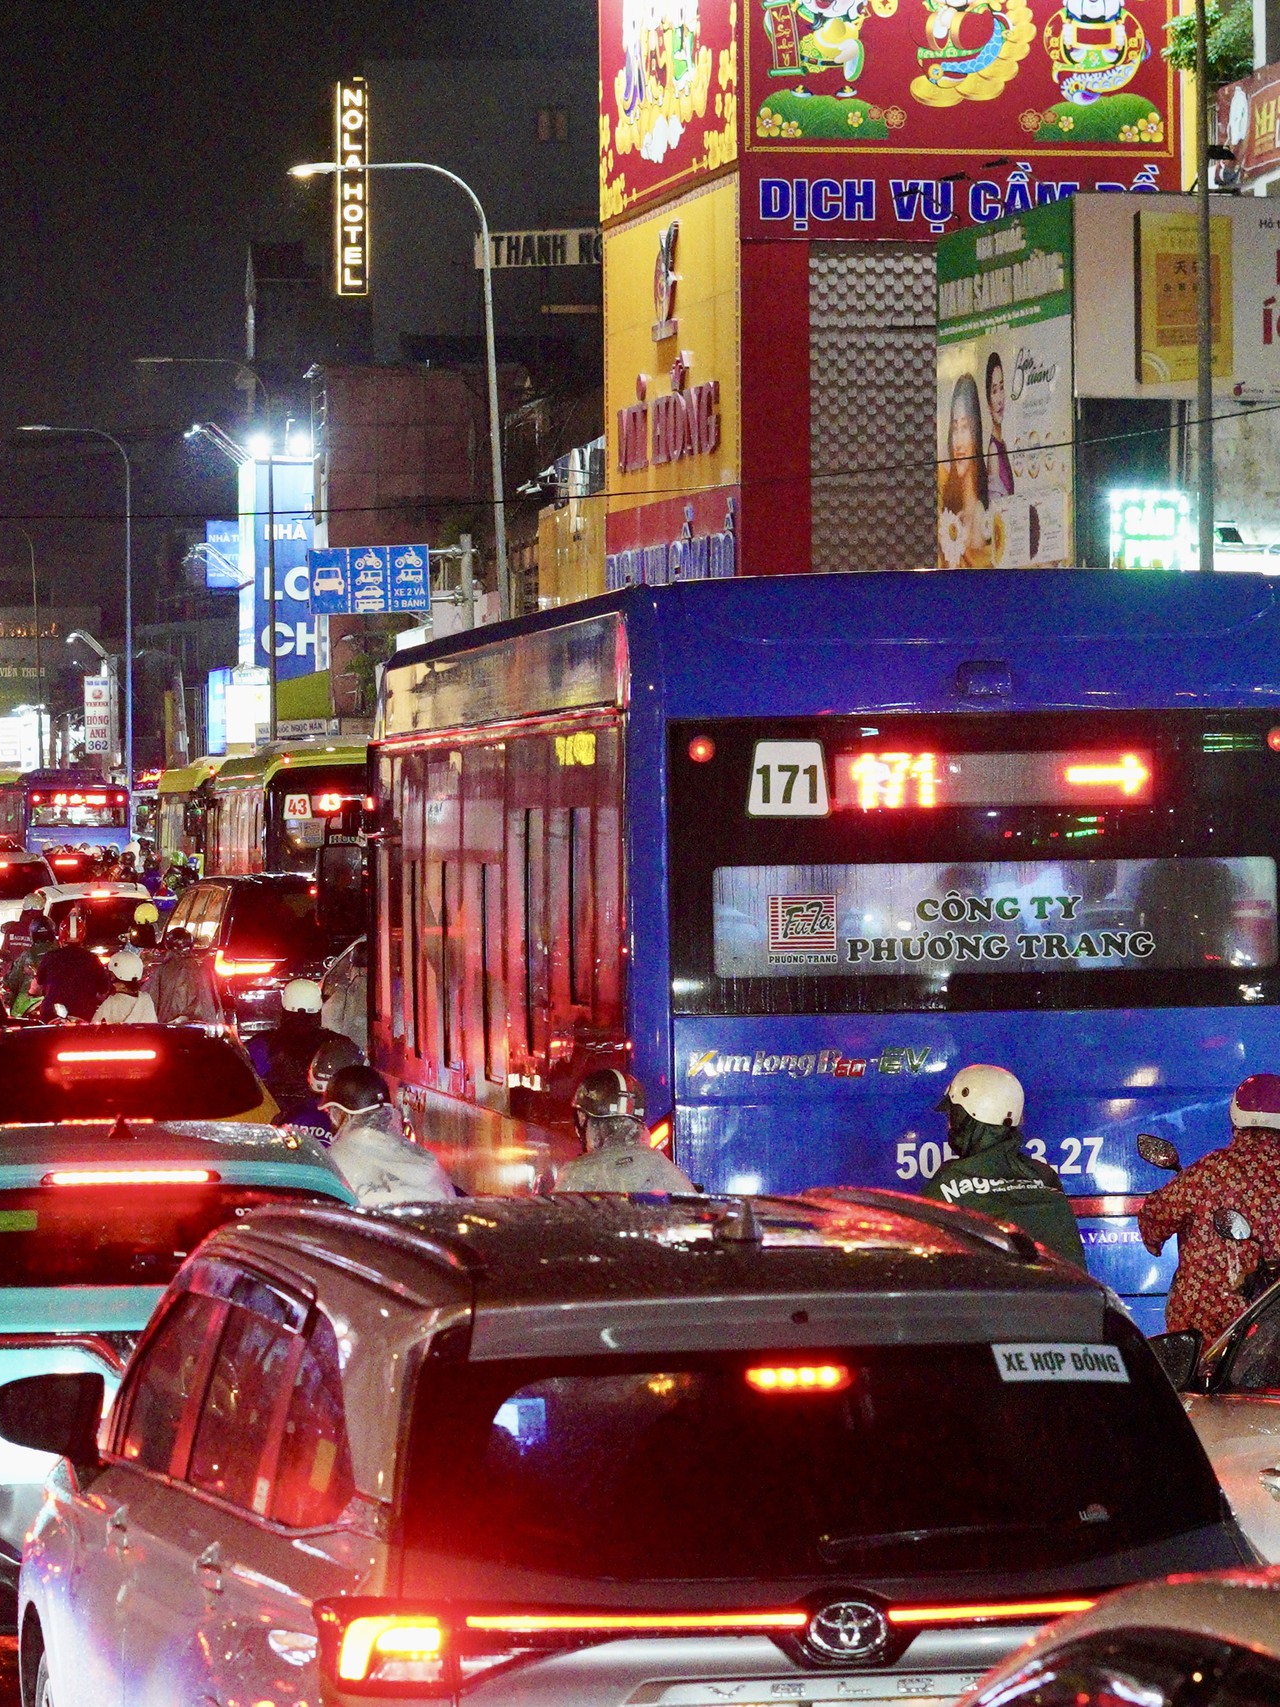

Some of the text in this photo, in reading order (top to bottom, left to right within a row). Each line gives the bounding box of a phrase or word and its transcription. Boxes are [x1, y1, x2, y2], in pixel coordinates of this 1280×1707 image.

[342, 89, 364, 286] NOLA HOTEL
[758, 178, 876, 231] DỊCH
[888, 179, 954, 233] VỤ
[490, 233, 567, 266] THANH
[264, 520, 308, 541] NHÀ
[394, 586, 426, 597] XE 2 VÀ
[394, 599, 426, 608] 3 BÁNH
[87, 740, 109, 751] 362
[89, 728, 108, 739] ANH
[756, 764, 818, 804] 171
[851, 752, 936, 809] 171
[288, 798, 308, 816] 43
[915, 889, 1083, 922] CÔNG TY
[807, 954, 838, 964] TRANG
[845, 930, 1157, 964] PHƯƠNG TRANG
[1088, 1230, 1142, 1243] VÀO TR
[1003, 1346, 1120, 1375] XE HỢP ĐỒNG
